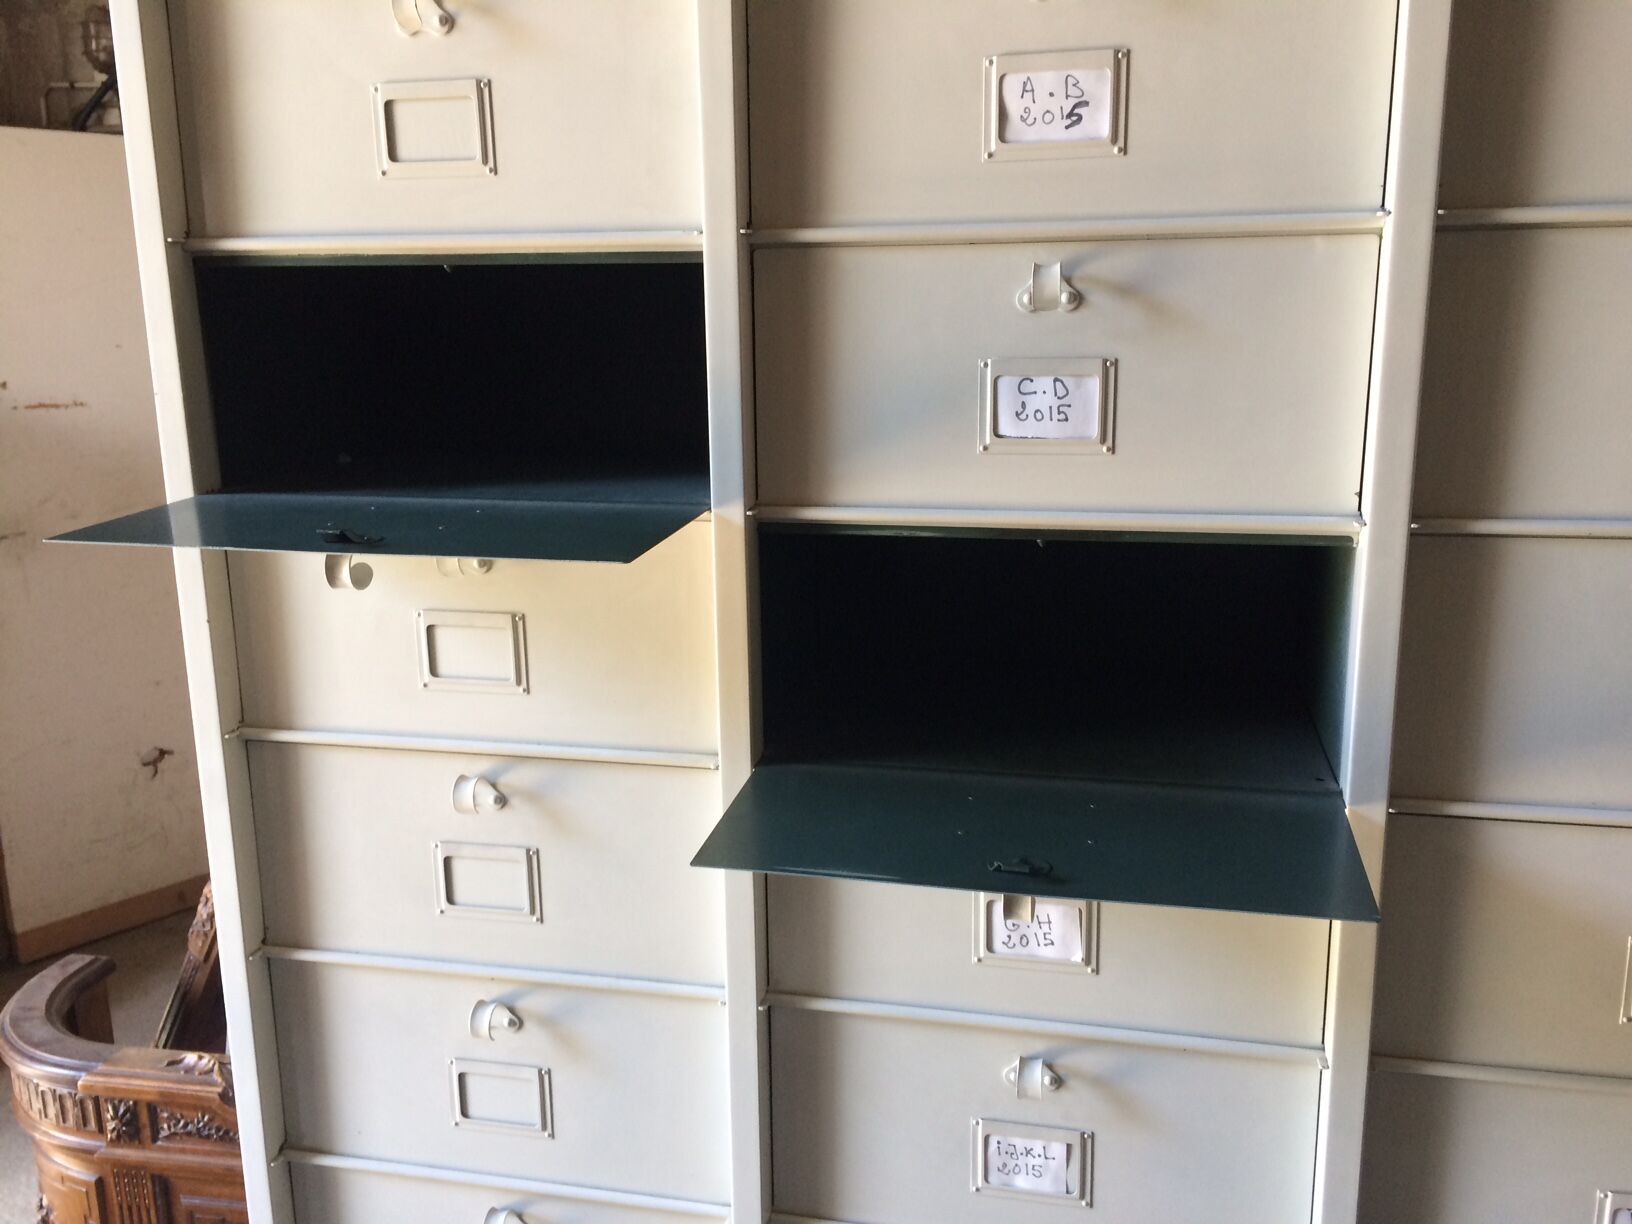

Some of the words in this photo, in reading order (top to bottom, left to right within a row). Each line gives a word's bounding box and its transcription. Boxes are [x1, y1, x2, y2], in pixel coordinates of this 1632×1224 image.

[1020, 100, 1090, 130] 2015
[1017, 377, 1070, 400] C.D
[1015, 400, 1072, 422] 2015
[1002, 932, 1055, 949] 2015
[997, 1162, 1043, 1179] 2015
